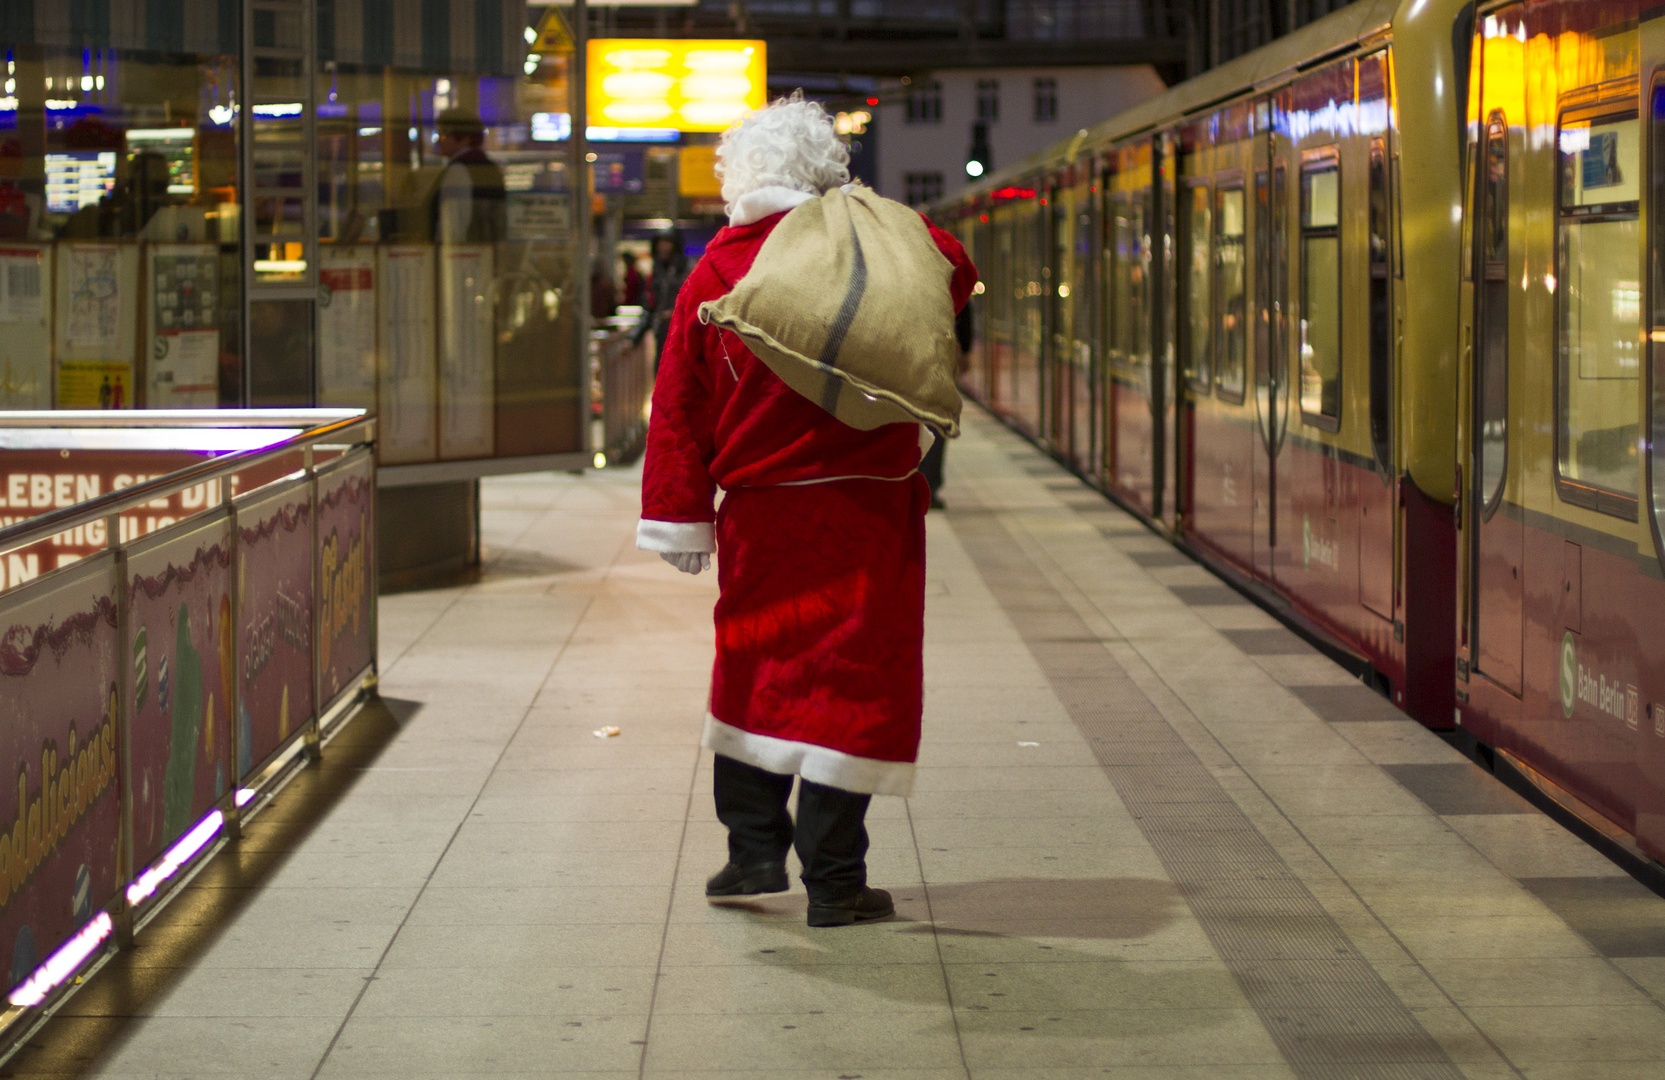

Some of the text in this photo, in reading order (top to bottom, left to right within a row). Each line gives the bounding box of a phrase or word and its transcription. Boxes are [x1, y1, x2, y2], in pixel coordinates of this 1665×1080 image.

[0, 474, 101, 508] EBEN
[1563, 638, 1638, 729] S Bahn Berlin DB
